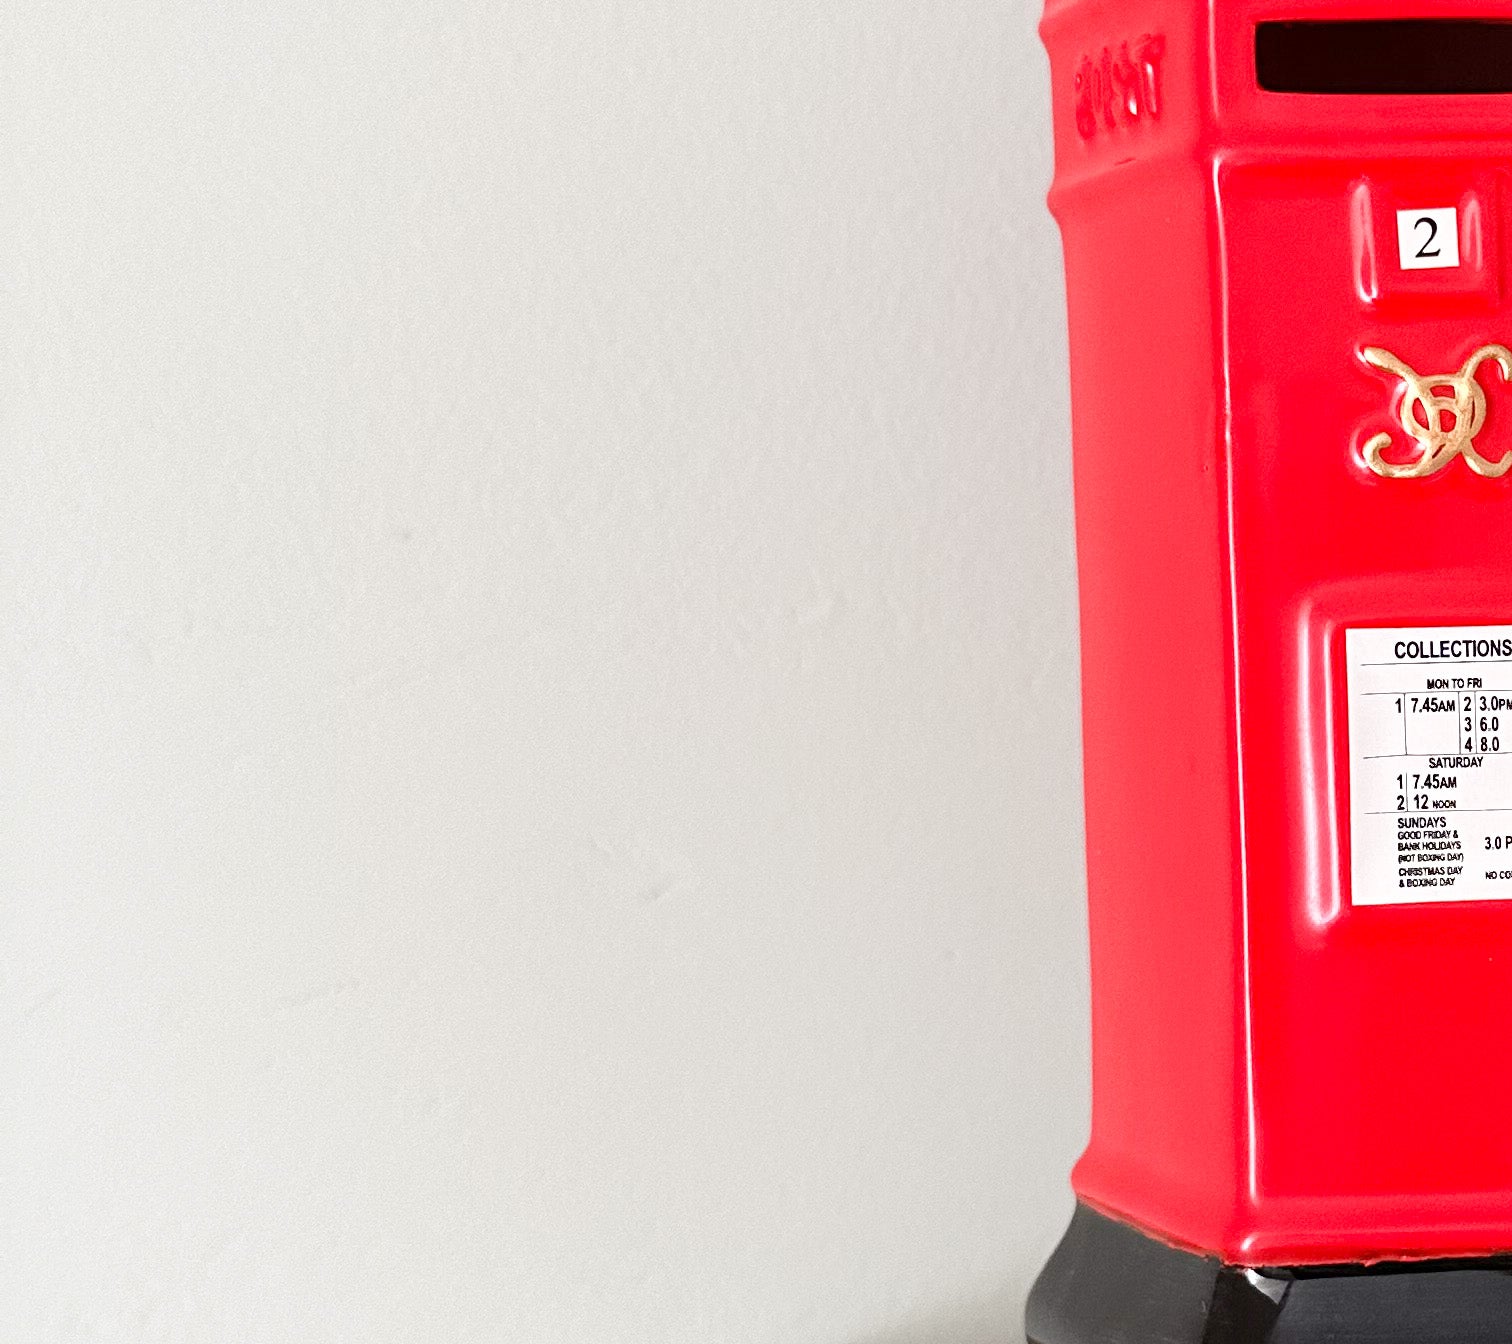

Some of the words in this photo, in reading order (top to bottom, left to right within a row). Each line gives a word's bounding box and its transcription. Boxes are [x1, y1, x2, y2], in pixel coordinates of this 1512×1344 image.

[1413, 216, 1442, 259] 2
[1394, 638, 1512, 659] COLLECTIONS
[1426, 678, 1450, 690] MON
[1450, 677, 1465, 689] TO
[1466, 677, 1483, 689] FRI
[1394, 697, 1402, 714] 1
[1410, 696, 1456, 713] 7.45AM
[1463, 696, 1472, 712] 2
[1464, 716, 1473, 733] 3
[1479, 716, 1499, 732] 6.0
[1464, 736, 1473, 753] 4
[1480, 736, 1500, 753] 8.0
[1428, 755, 1484, 769] SATURDAY
[1396, 773, 1403, 790] 1
[1412, 773, 1458, 790] 7.45AM
[1396, 794, 1406, 811] 2
[1413, 793, 1429, 810] 12
[1432, 799, 1457, 810] NOON
[1397, 816, 1447, 829] SUNDAYS
[1397, 830, 1422, 841] GOOD
[1423, 829, 1452, 840] FRIDAY
[1397, 841, 1421, 852] BANK
[1422, 840, 1462, 851] HOLIDAYS
[1484, 835, 1502, 851] 3.0
[1417, 853, 1446, 863] BOXING
[1398, 866, 1446, 877] CHRISTMAS
[1446, 865, 1464, 876] DAY
[1406, 877, 1438, 888] BOXING
[1439, 876, 1456, 887] DAY
